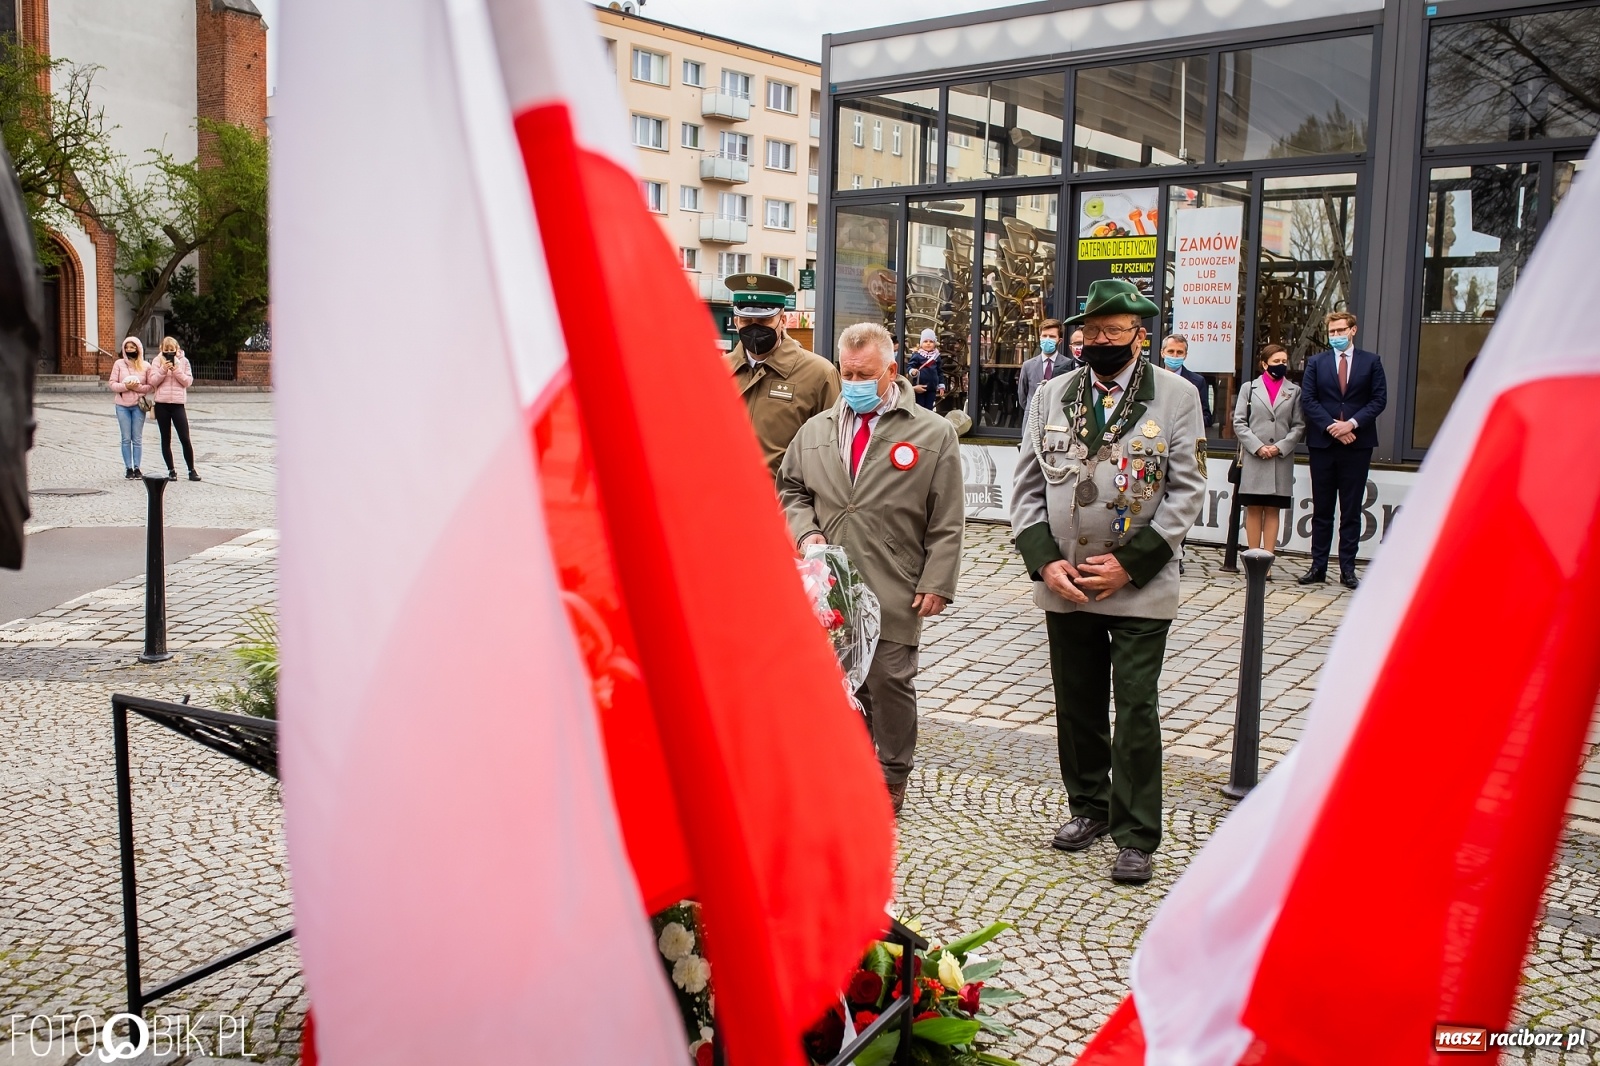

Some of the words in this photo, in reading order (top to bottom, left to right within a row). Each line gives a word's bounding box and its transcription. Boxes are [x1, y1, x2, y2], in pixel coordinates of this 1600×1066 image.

[1180, 232, 1239, 252] ZAMÓW
[1080, 242, 1111, 257] CATERING
[1112, 240, 1156, 256] DIETETYCZNY
[1181, 258, 1186, 266] Z
[1189, 256, 1236, 266] DOWOZEM
[1111, 263, 1123, 273] BEZ
[1124, 262, 1155, 273] PSZENICY
[1197, 270, 1216, 278] LUB
[1183, 283, 1232, 292] ODBIOREM
[1182, 296, 1190, 305] W
[1193, 295, 1231, 305] LOKALU
[1179, 321, 1188, 330] 32
[1191, 321, 1204, 330] 415
[1207, 321, 1218, 330] 84
[1221, 321, 1232, 330] 84
[1191, 333, 1204, 342] 415
[1207, 333, 1218, 342] 74
[1221, 333, 1231, 342] 75
[965, 486, 992, 506] ynek
